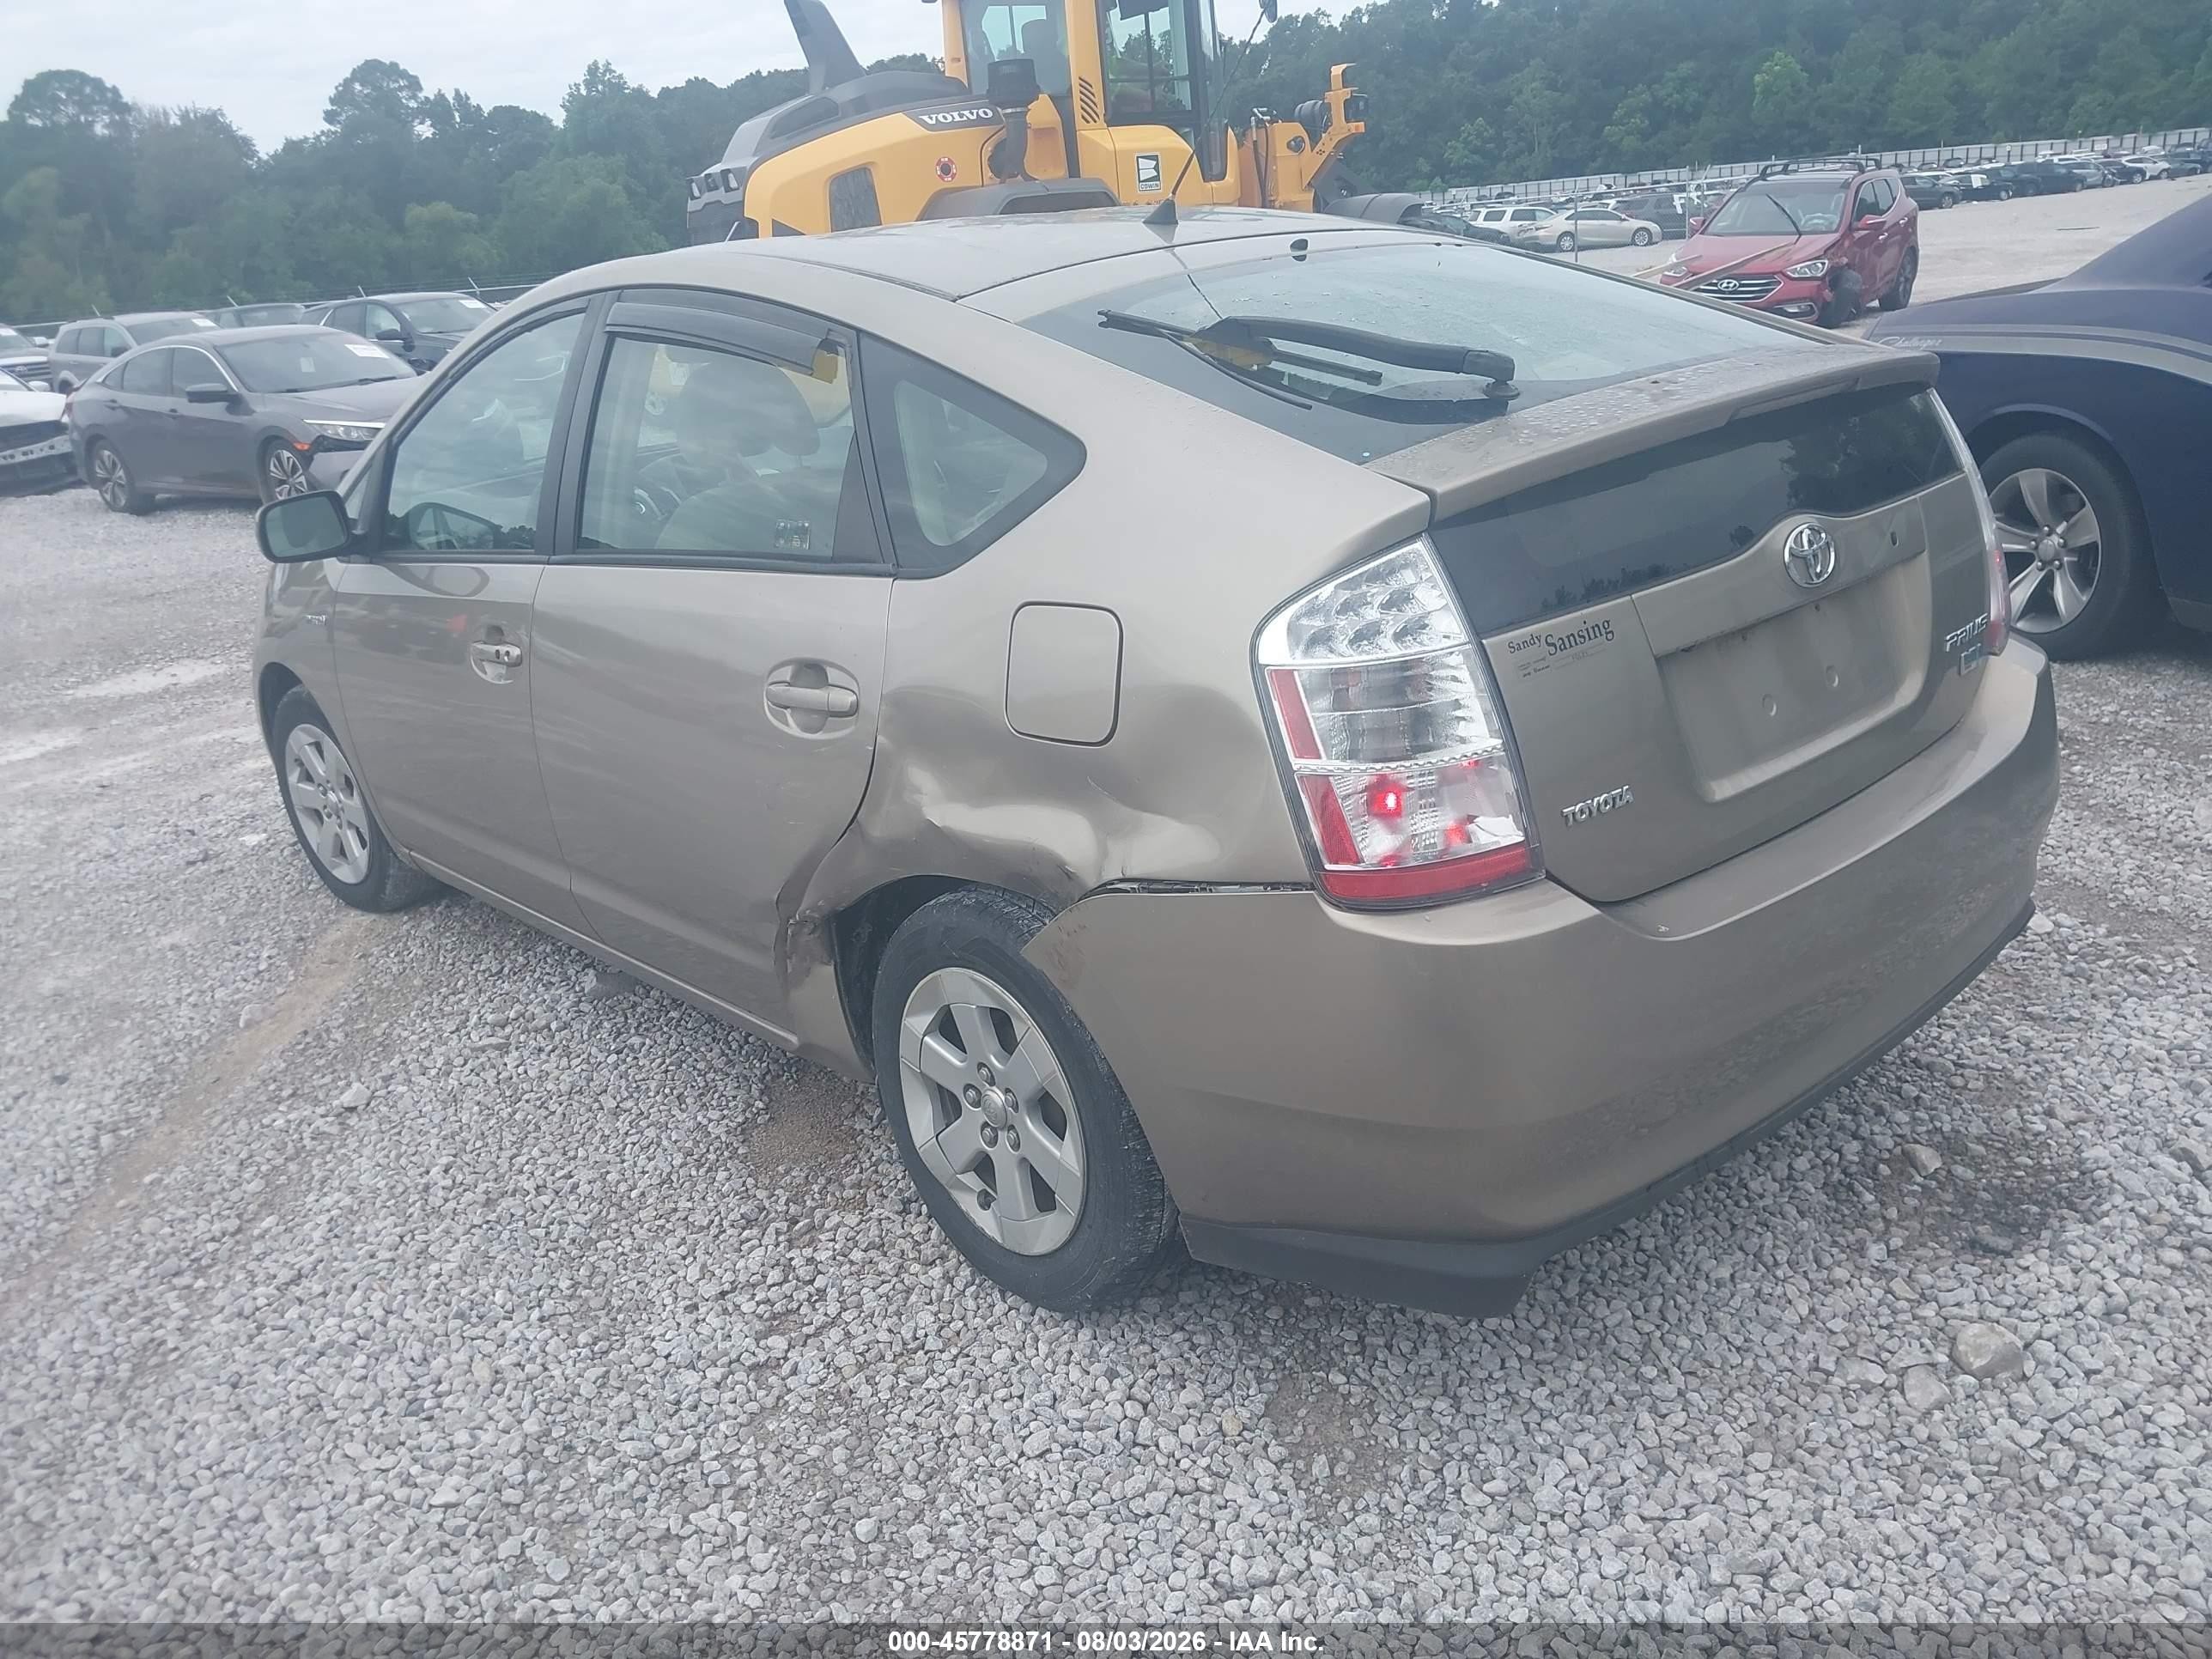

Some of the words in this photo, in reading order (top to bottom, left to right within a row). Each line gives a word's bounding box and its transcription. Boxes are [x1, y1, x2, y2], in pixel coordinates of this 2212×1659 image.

[919, 108, 994, 125] VOLVO
[1507, 633, 1542, 654] Sandy
[1545, 619, 1615, 656] Sansing
[1944, 612, 1988, 653] PRIUS
[1561, 785, 1634, 827] TOYOTA
